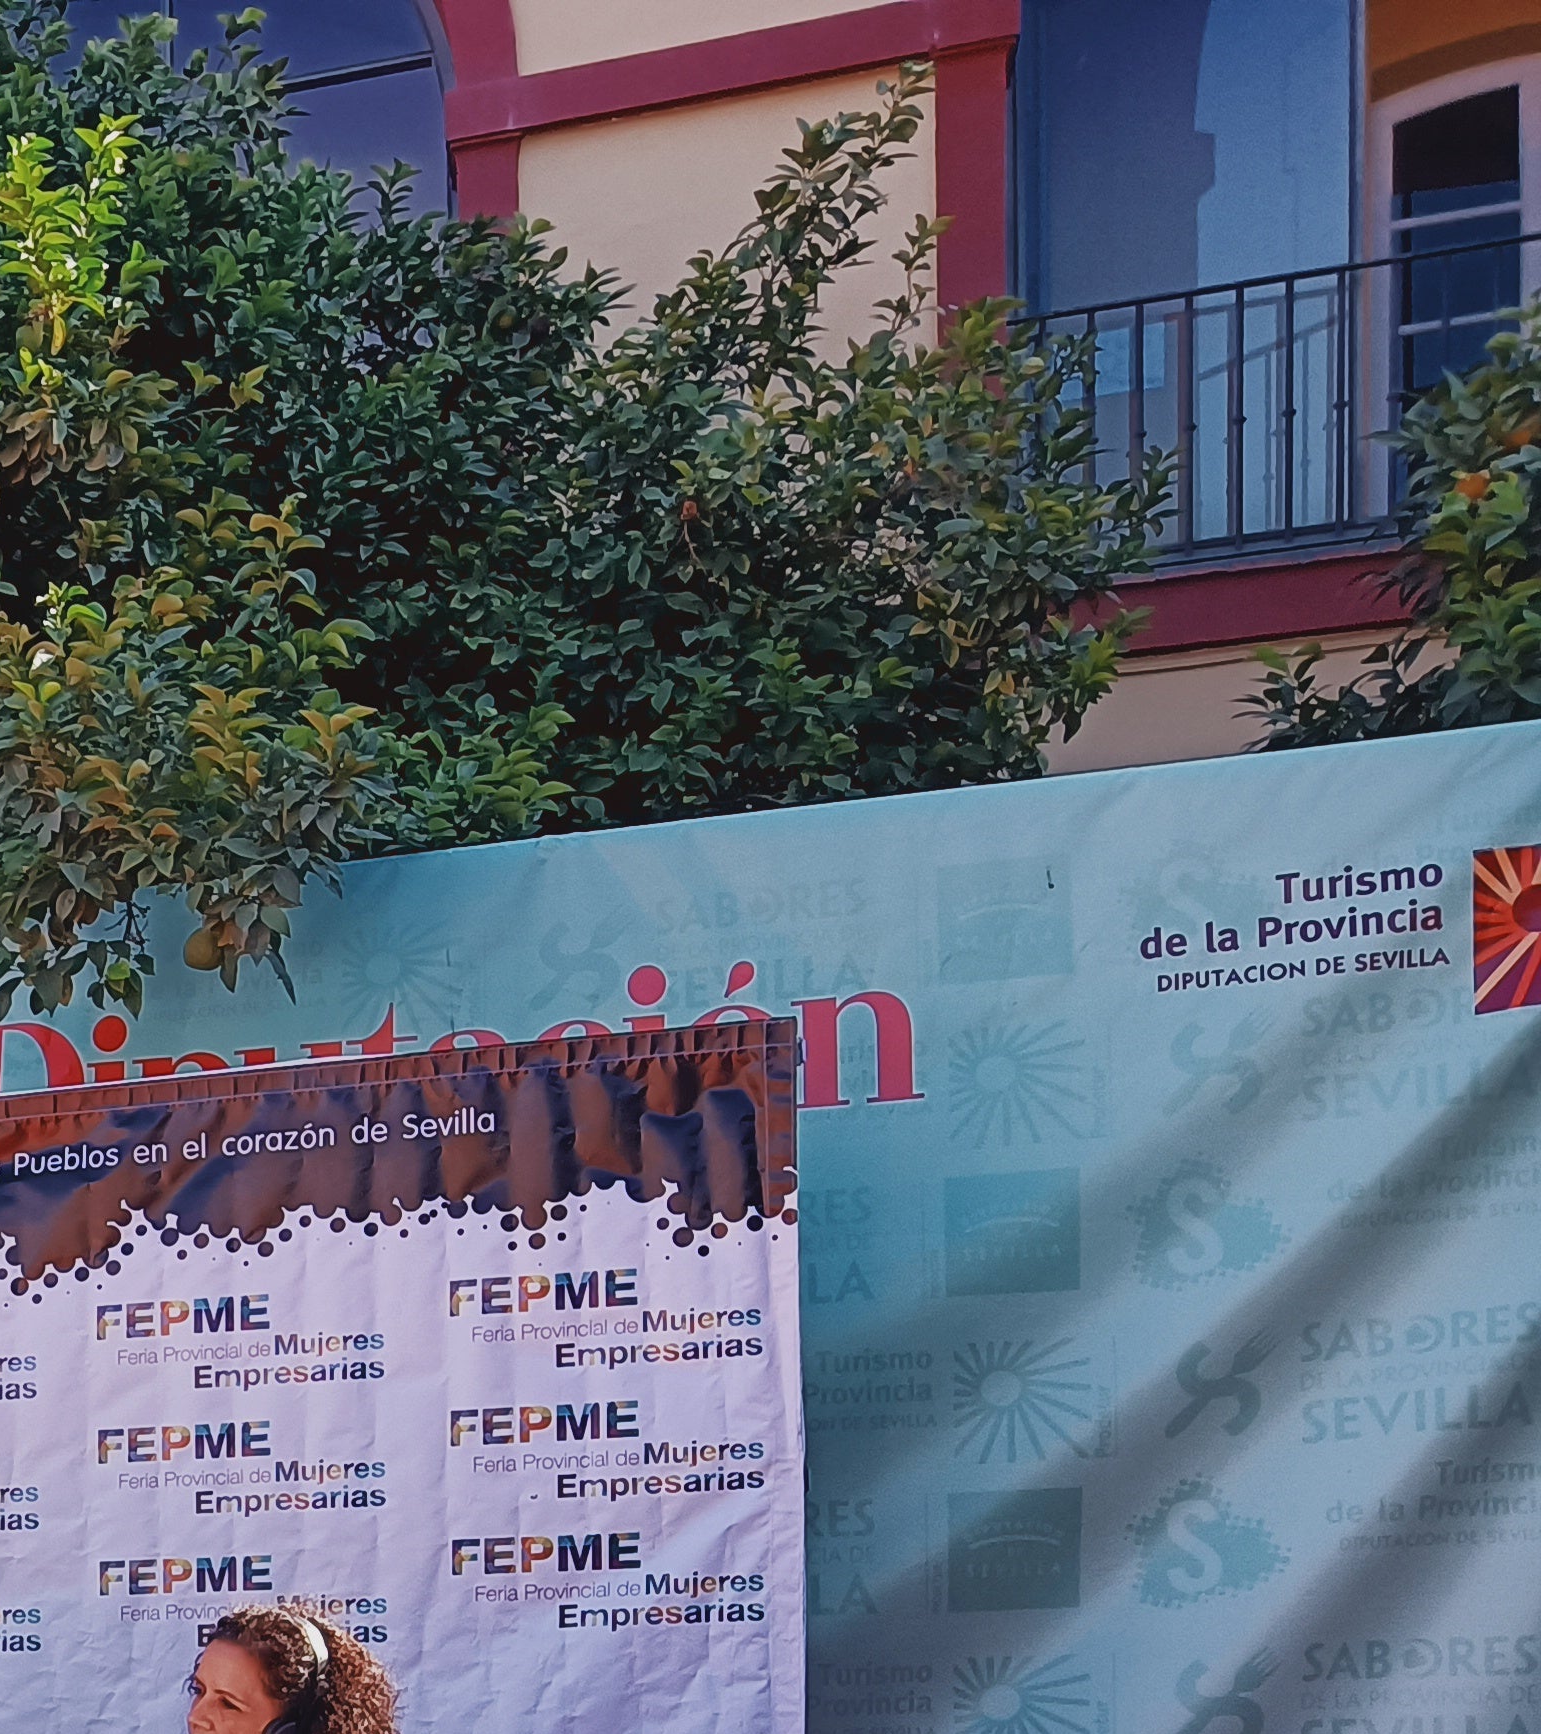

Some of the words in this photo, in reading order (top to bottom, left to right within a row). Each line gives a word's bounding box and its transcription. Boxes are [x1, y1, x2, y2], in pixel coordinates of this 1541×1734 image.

[1275, 863, 1443, 907] Turismo
[1140, 926, 1188, 960] de
[1205, 921, 1240, 954] la
[1258, 898, 1444, 948] Provincia
[1157, 959, 1306, 993] DIPUTACION
[1315, 955, 1346, 976] DE
[1354, 947, 1451, 973] SEVILLA
[14, 1144, 119, 1176] Pueblos
[133, 1143, 167, 1164] en
[182, 1132, 206, 1160] el
[221, 1122, 335, 1156] corazón
[351, 1116, 388, 1144] de
[402, 1106, 495, 1139] Sevilla
[449, 1268, 639, 1318] FEPME
[96, 1293, 271, 1341] FEPME
[472, 1324, 516, 1343] Feria
[521, 1318, 608, 1341] Provincial
[613, 1318, 639, 1335] de
[642, 1308, 762, 1334] Mujeres
[117, 1348, 159, 1366] Feria
[163, 1341, 243, 1363] Provincial
[247, 1341, 271, 1358] de
[274, 1333, 385, 1357] Mujeres
[555, 1337, 763, 1370] Empresarias
[194, 1361, 385, 1392] Empresarias
[451, 1531, 642, 1576] FEPME
[475, 1585, 519, 1602] Feria
[524, 1582, 611, 1601] Provincial
[616, 1580, 641, 1598] de
[645, 1570, 764, 1599] Mujeres
[558, 1603, 765, 1632] Empresarias
